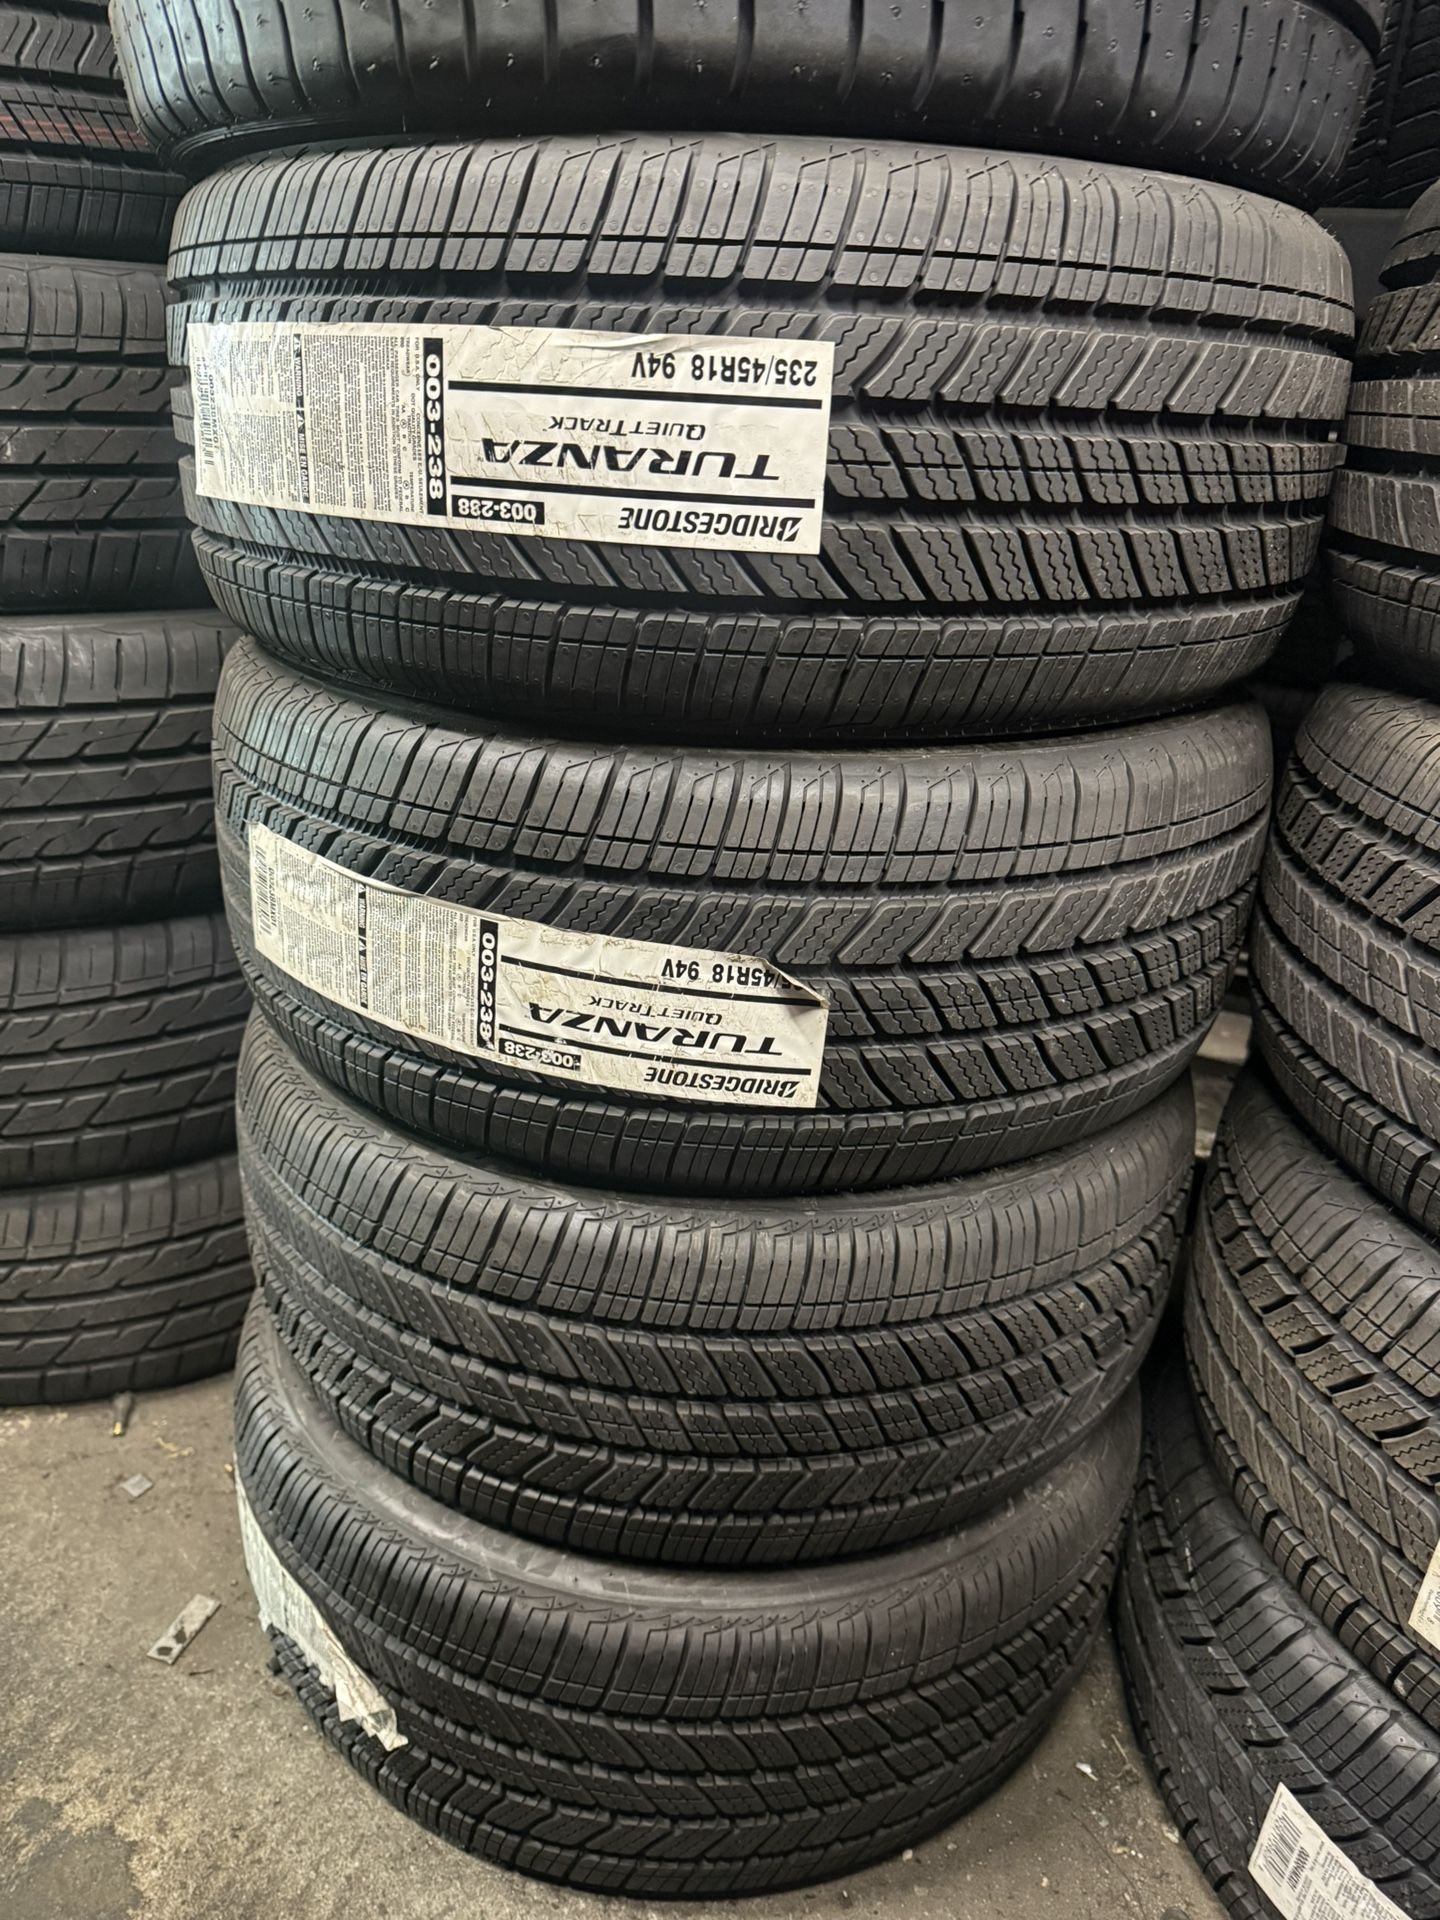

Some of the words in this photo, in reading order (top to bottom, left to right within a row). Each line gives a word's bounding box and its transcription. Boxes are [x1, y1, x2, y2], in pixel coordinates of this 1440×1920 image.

[631, 352, 675, 379] 94V
[691, 355, 818, 386] 235/45R18
[425, 354, 444, 499] 003-238
[300, 456, 307, 468] EN
[481, 437, 780, 480] TURANZA
[618, 507, 803, 542] BRIDGESTONE
[662, 959, 699, 979] 94V
[480, 932, 495, 1041] 003-238
[529, 1002, 783, 1055] TURANZA
[504, 1041, 573, 1068] 003-238
[644, 1067, 800, 1098] BRIDGESTONE
